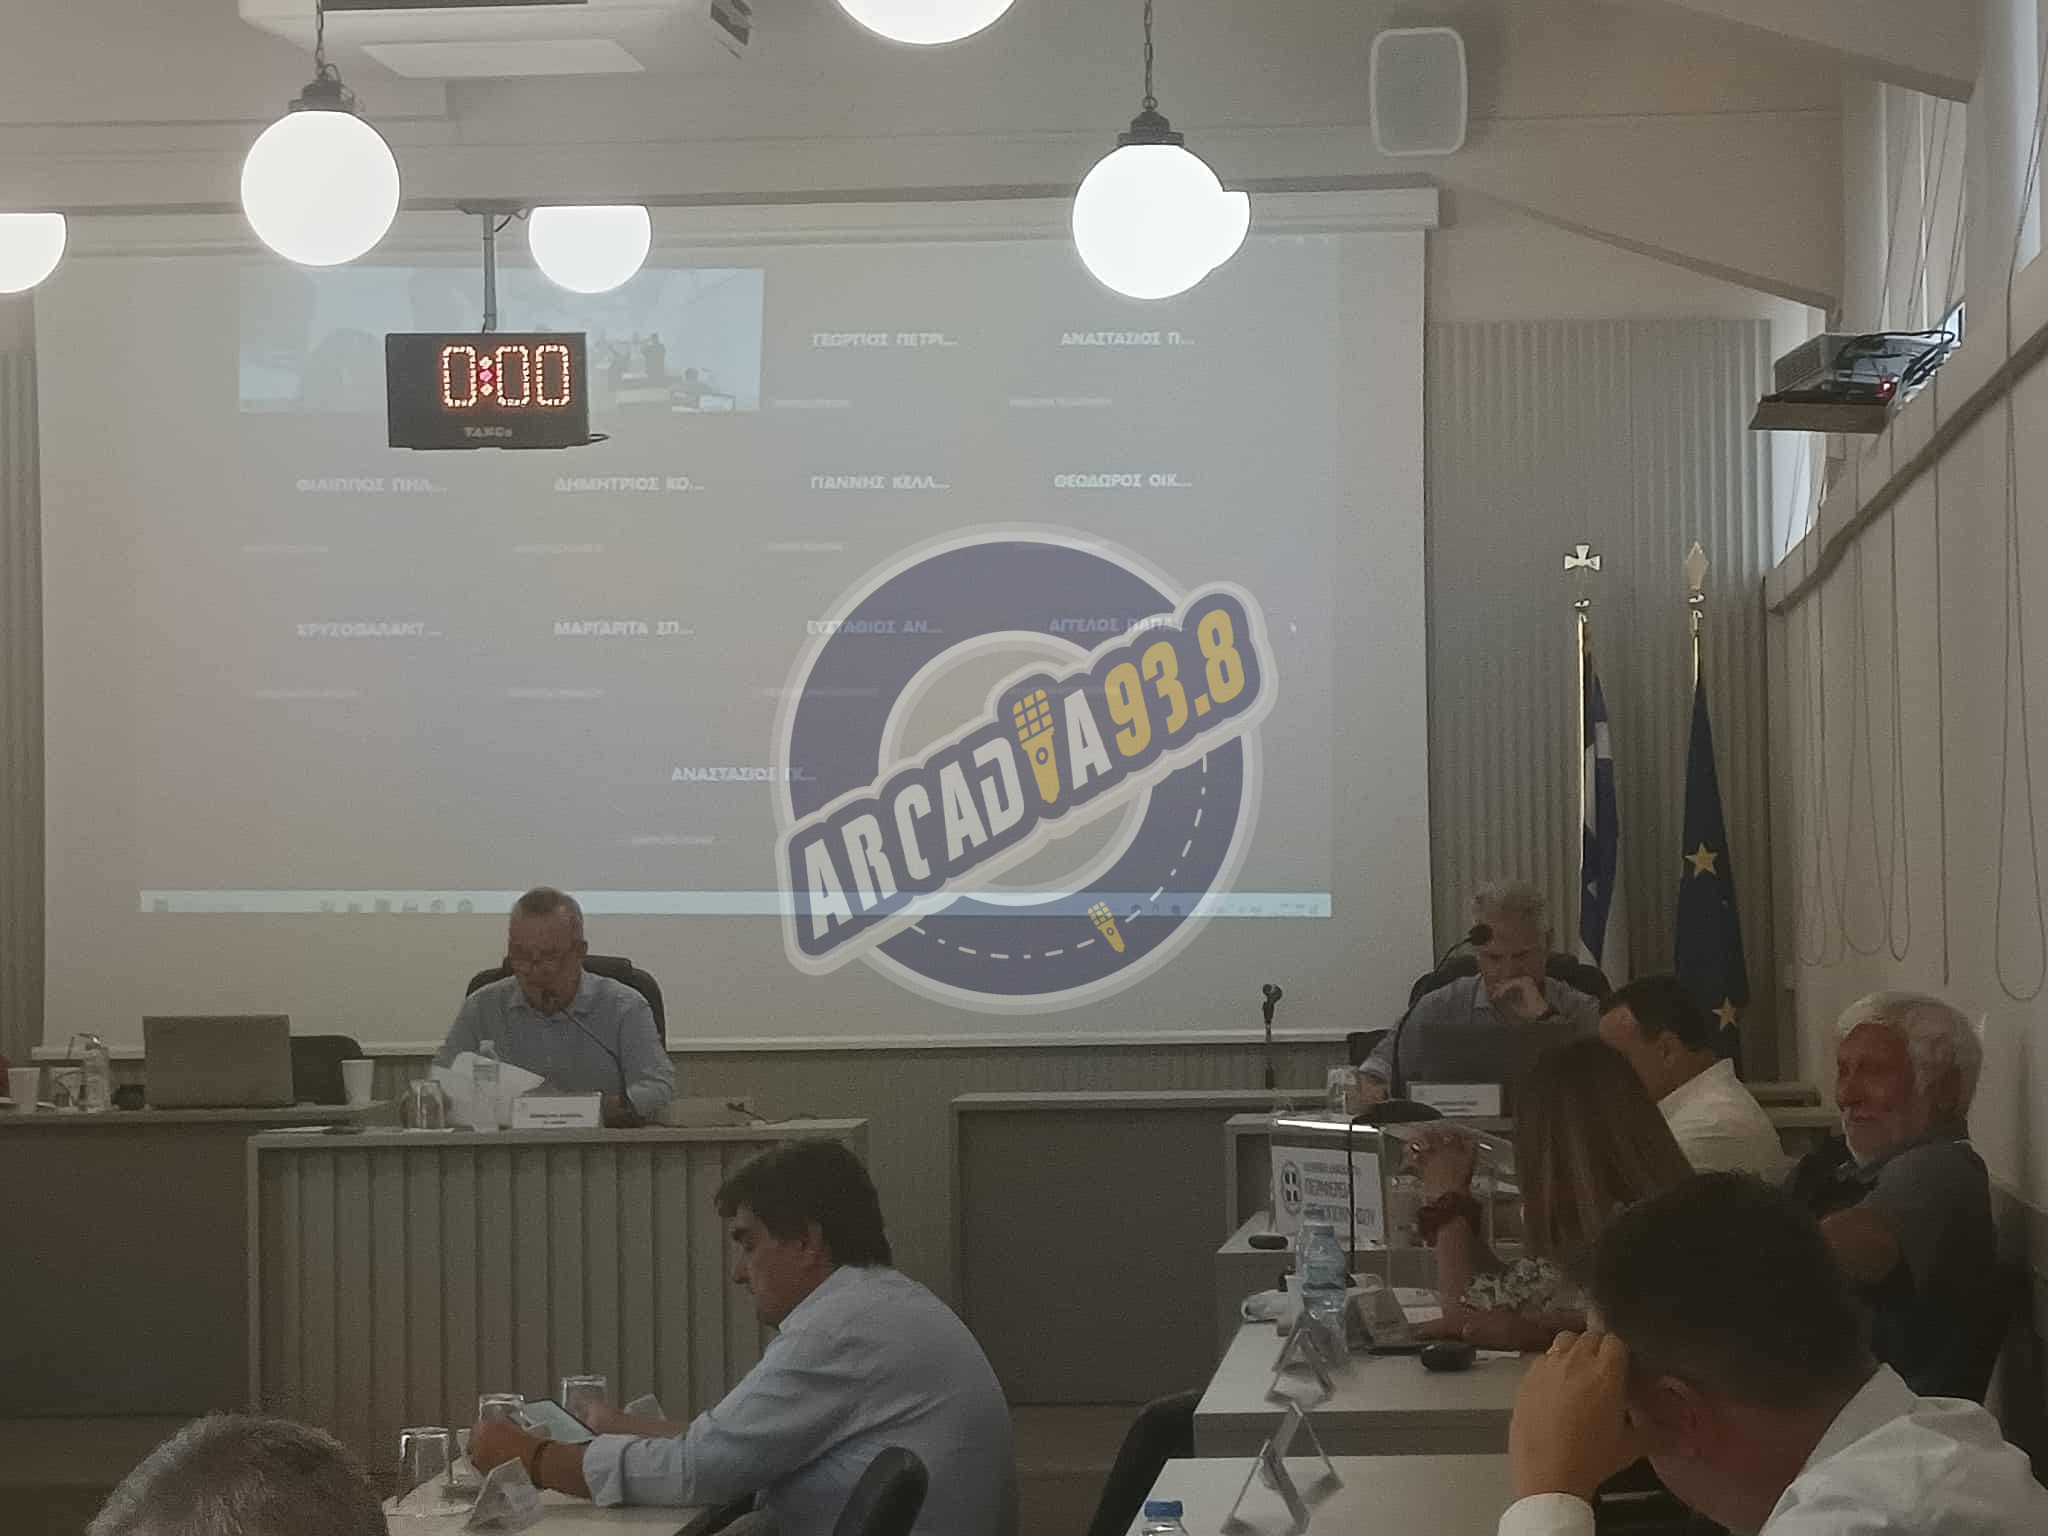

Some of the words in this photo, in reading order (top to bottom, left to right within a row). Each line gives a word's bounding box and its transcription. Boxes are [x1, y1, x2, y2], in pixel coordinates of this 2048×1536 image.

[442, 345, 570, 407] 0:00
[810, 474, 884, 489] ΓΙΑΝΝΗΣ
[1054, 473, 1142, 488] ΘΕΟΔΩΡΟΣ
